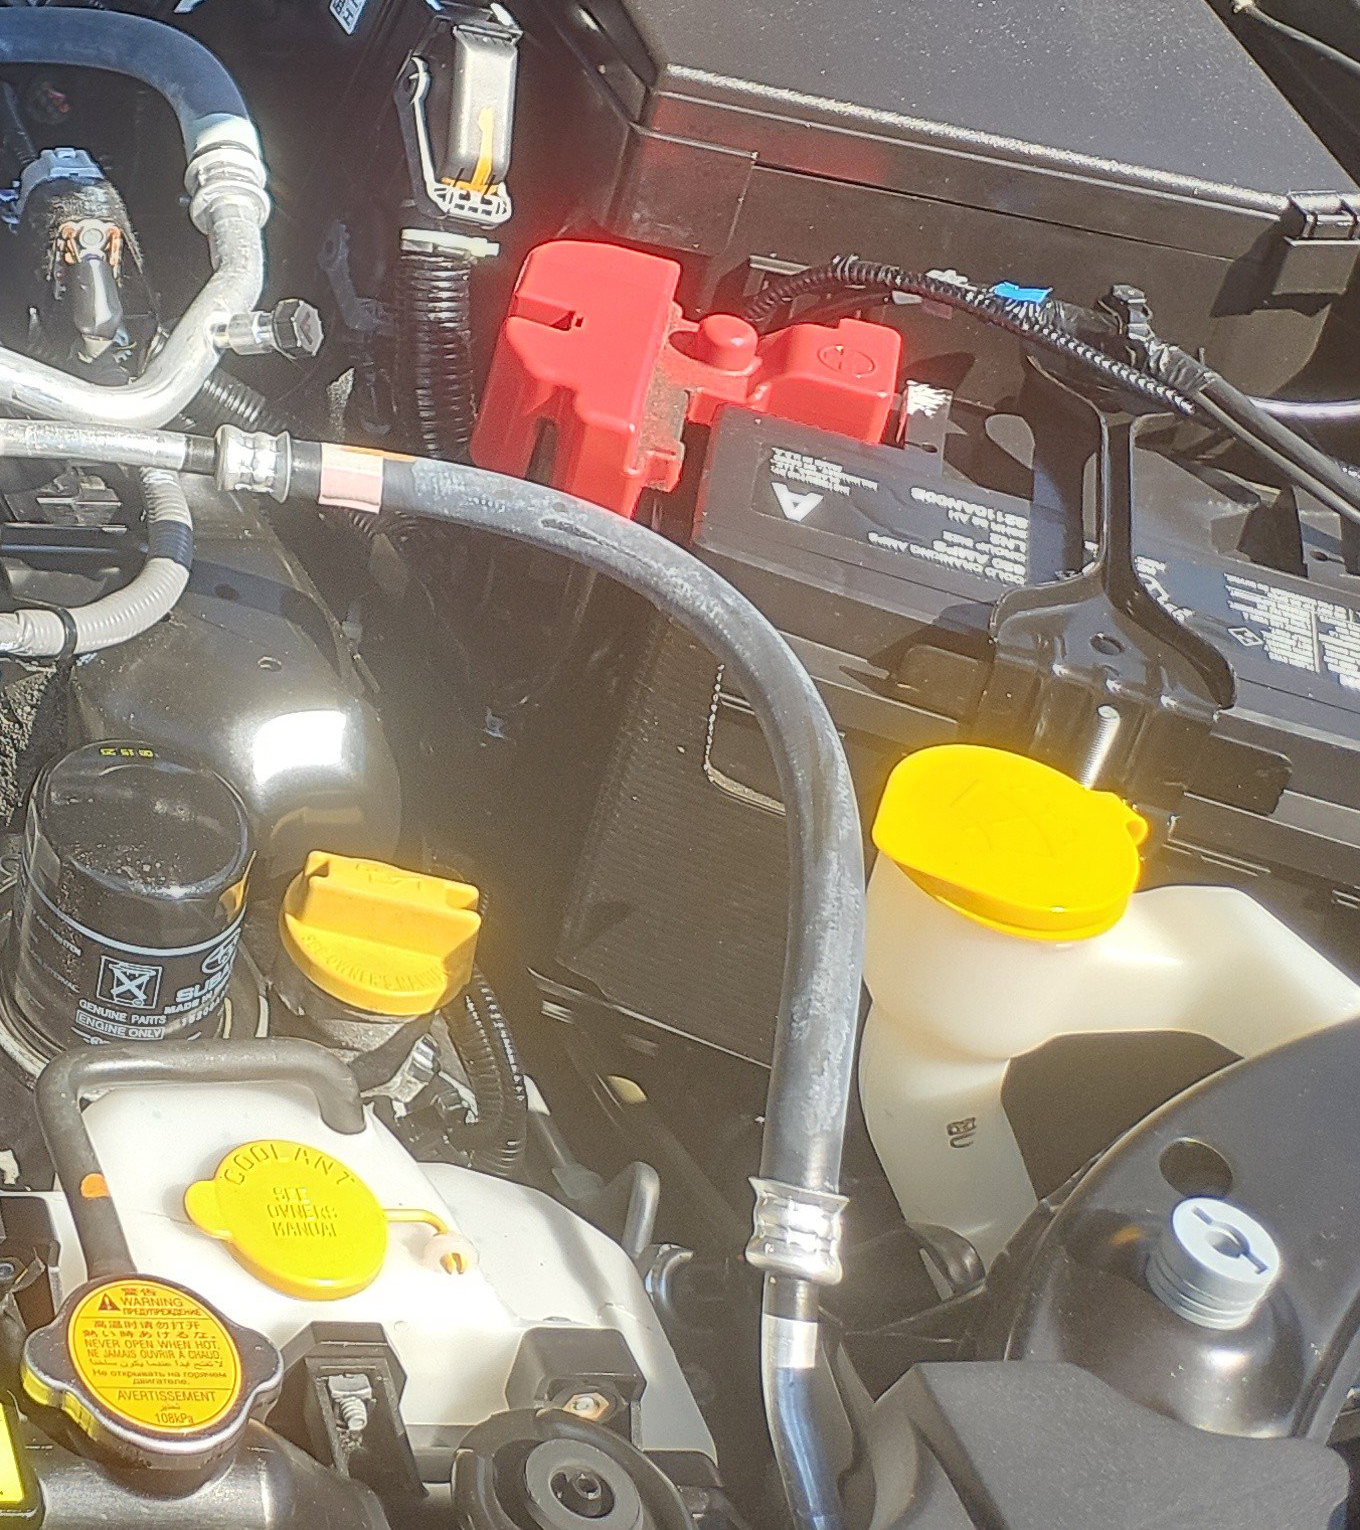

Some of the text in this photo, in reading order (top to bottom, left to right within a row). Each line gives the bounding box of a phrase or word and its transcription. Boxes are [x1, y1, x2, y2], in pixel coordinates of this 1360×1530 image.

[79, 999, 166, 1025] GENUINE PARTS
[164, 998, 200, 1015] MADE
[79, 1013, 126, 1037] ENGINE
[128, 1028, 162, 1038] ONLY
[224, 1143, 357, 1186] COOLANT
[272, 1186, 309, 1202] SEE
[120, 1297, 184, 1308] WARNING
[84, 1339, 123, 1349] NEVER
[125, 1340, 154, 1349] OPEN
[158, 1340, 191, 1350] WHEN
[87, 1349, 99, 1358] NE
[103, 1349, 137, 1359] JAMAIS
[140, 1349, 176, 1359] OUVRIR
[117, 1390, 216, 1402] AVERTISSEMENT
[155, 1412, 195, 1424] 108kPa
